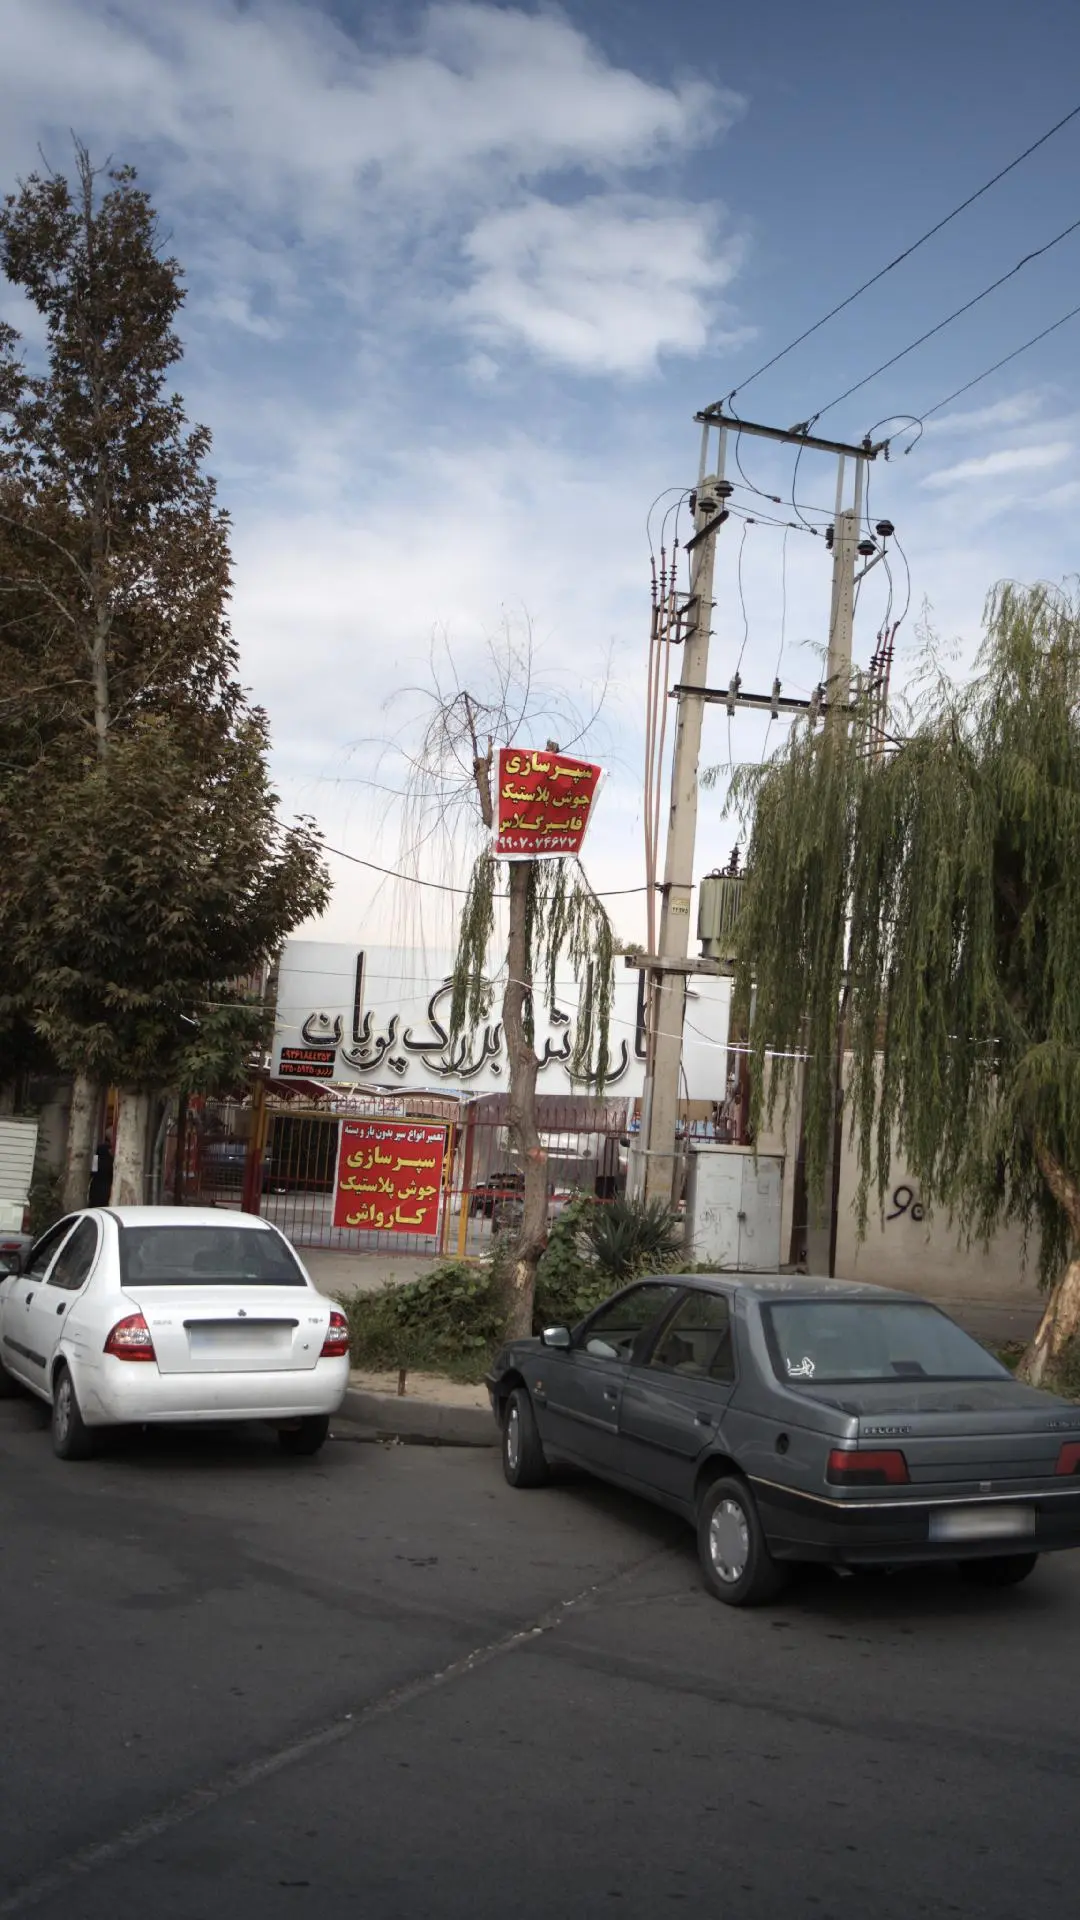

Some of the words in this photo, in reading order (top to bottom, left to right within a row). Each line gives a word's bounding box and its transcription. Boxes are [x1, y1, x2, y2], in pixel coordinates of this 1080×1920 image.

[501, 783, 550, 806] پلاستیک
[552, 790, 590, 809] جوش
[301, 950, 409, 1075] پویان
[375, 1129, 393, 1140] بدون
[407, 1128, 426, 1143] انواع
[425, 1130, 444, 1143] تعمیر
[339, 1175, 395, 1199] پلاستیک
[397, 1179, 437, 1201] جوش
[345, 1203, 427, 1228] کارواش
